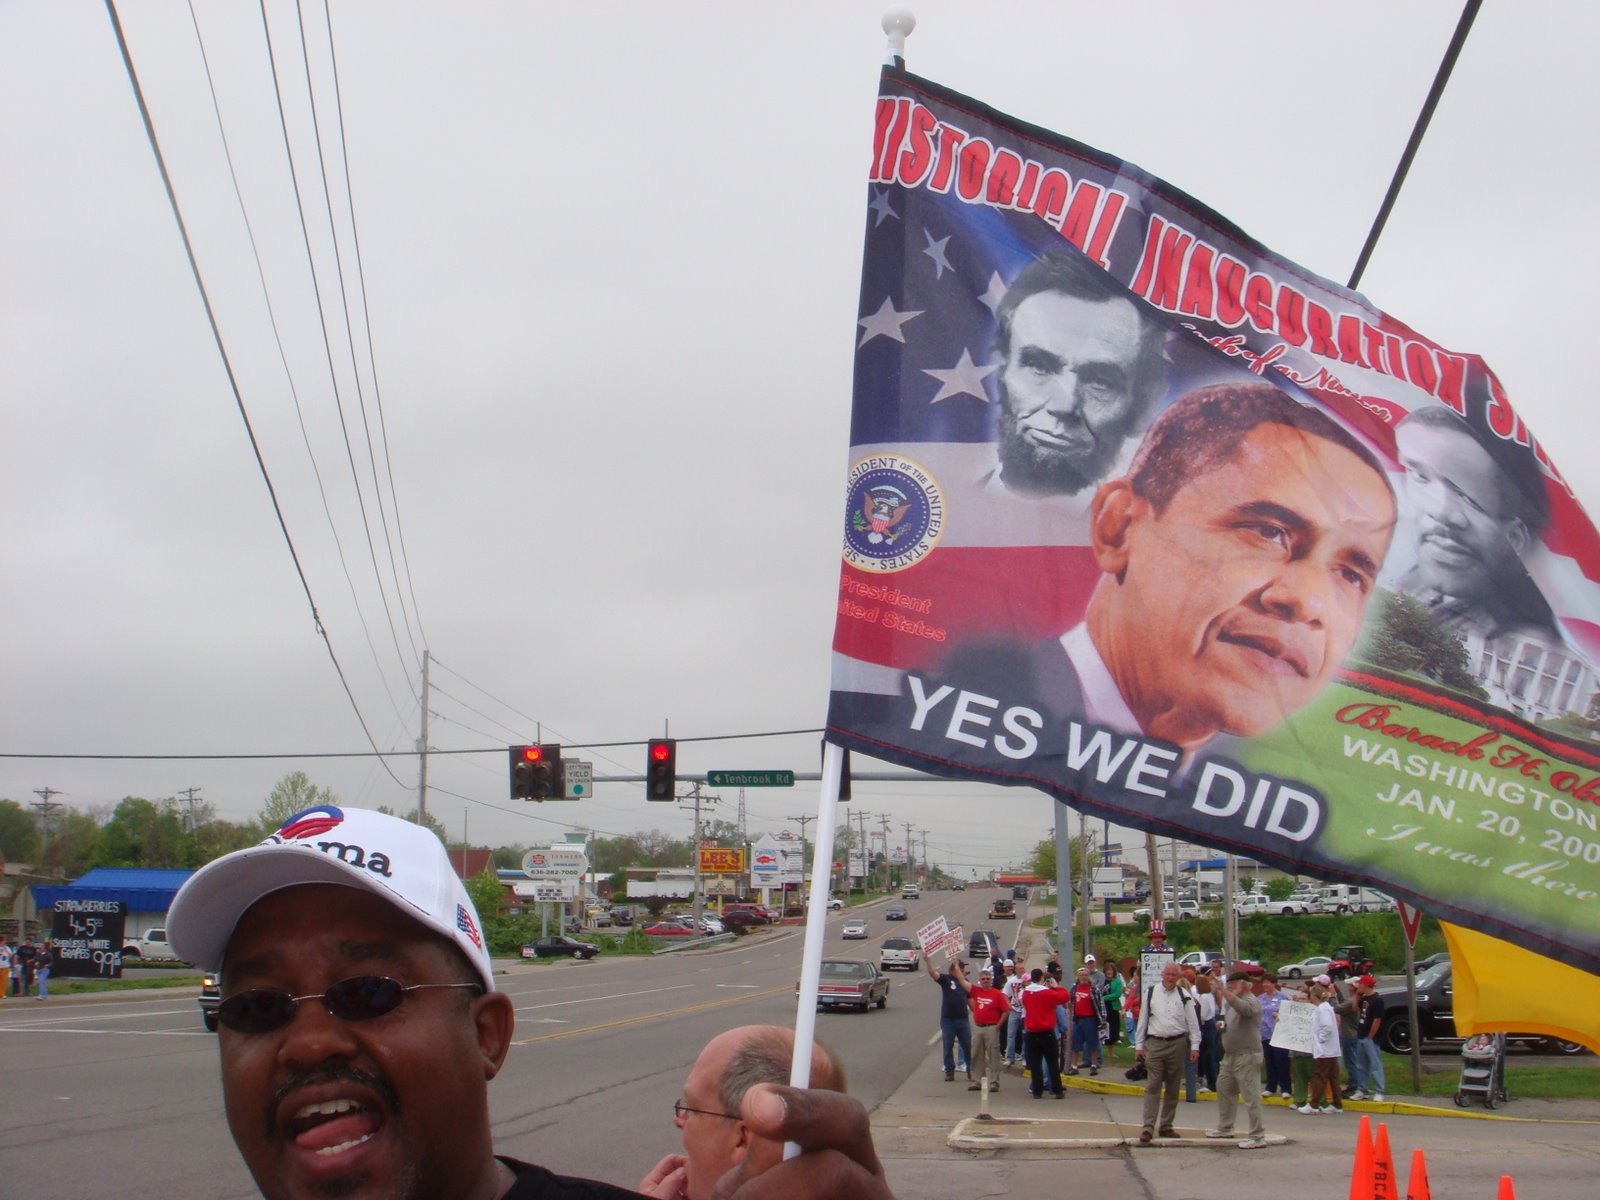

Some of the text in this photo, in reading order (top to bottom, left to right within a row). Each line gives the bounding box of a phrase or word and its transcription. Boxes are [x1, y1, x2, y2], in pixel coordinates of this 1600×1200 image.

[1129, 213, 1468, 416] INAUGURATION
[846, 458, 897, 494] RESIDENT
[900, 462, 912, 471] OF
[913, 469, 928, 484] THE
[926, 485, 942, 538] UNITED
[880, 541, 929, 570] STATES
[841, 575, 932, 614] President
[882, 611, 946, 641] States
[906, 675, 1320, 842] YES WE DID
[1335, 703, 1501, 761] Barack
[1489, 744, 1549, 780] H.
[724, 774, 789, 784] Tenbrook Rd
[1343, 734, 1597, 831] WASHINGTON
[1377, 783, 1463, 823] JAN.
[1476, 809, 1525, 844] 20,
[1414, 841, 1494, 869] was
[1502, 860, 1598, 900] there
[54, 900, 120, 913] STRAWBERRIES
[60, 948, 91, 959] GRAPES
[88, 940, 111, 949] WHITE
